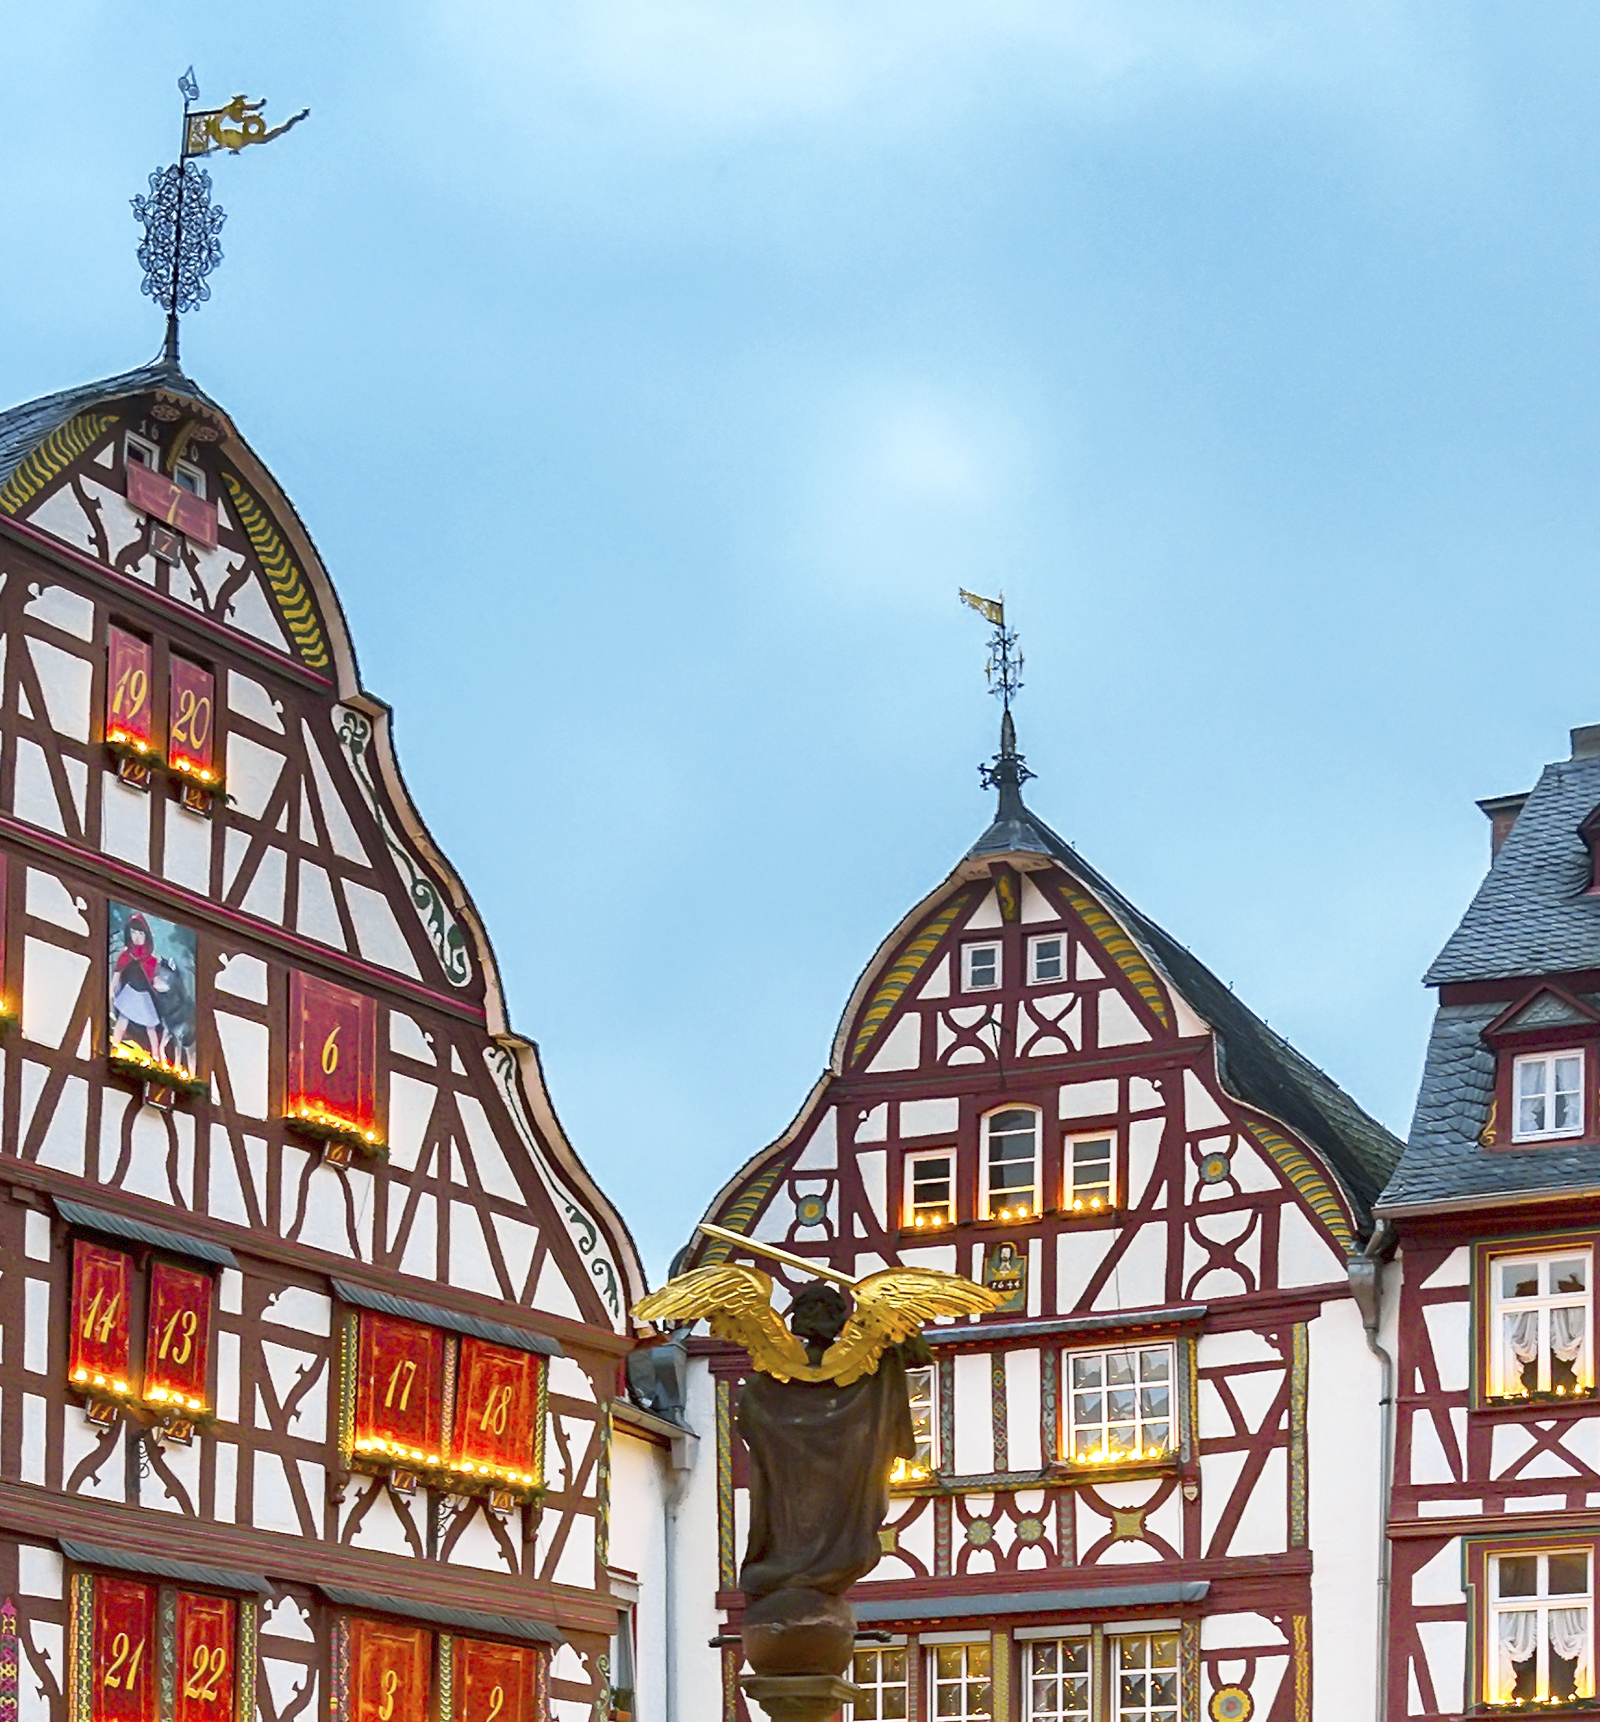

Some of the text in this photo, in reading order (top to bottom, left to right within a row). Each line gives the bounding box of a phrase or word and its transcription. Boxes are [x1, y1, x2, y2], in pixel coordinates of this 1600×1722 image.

[167, 485, 181, 526] 7
[161, 536, 173, 552] 7
[112, 665, 211, 749] 19 20
[322, 1026, 341, 1075] 6
[331, 1145, 344, 1160] 6
[83, 1287, 197, 1365] 14 13
[385, 1361, 513, 1435] 17 18
[104, 1632, 226, 1702] 21 22
[380, 1670, 398, 1721] 3
